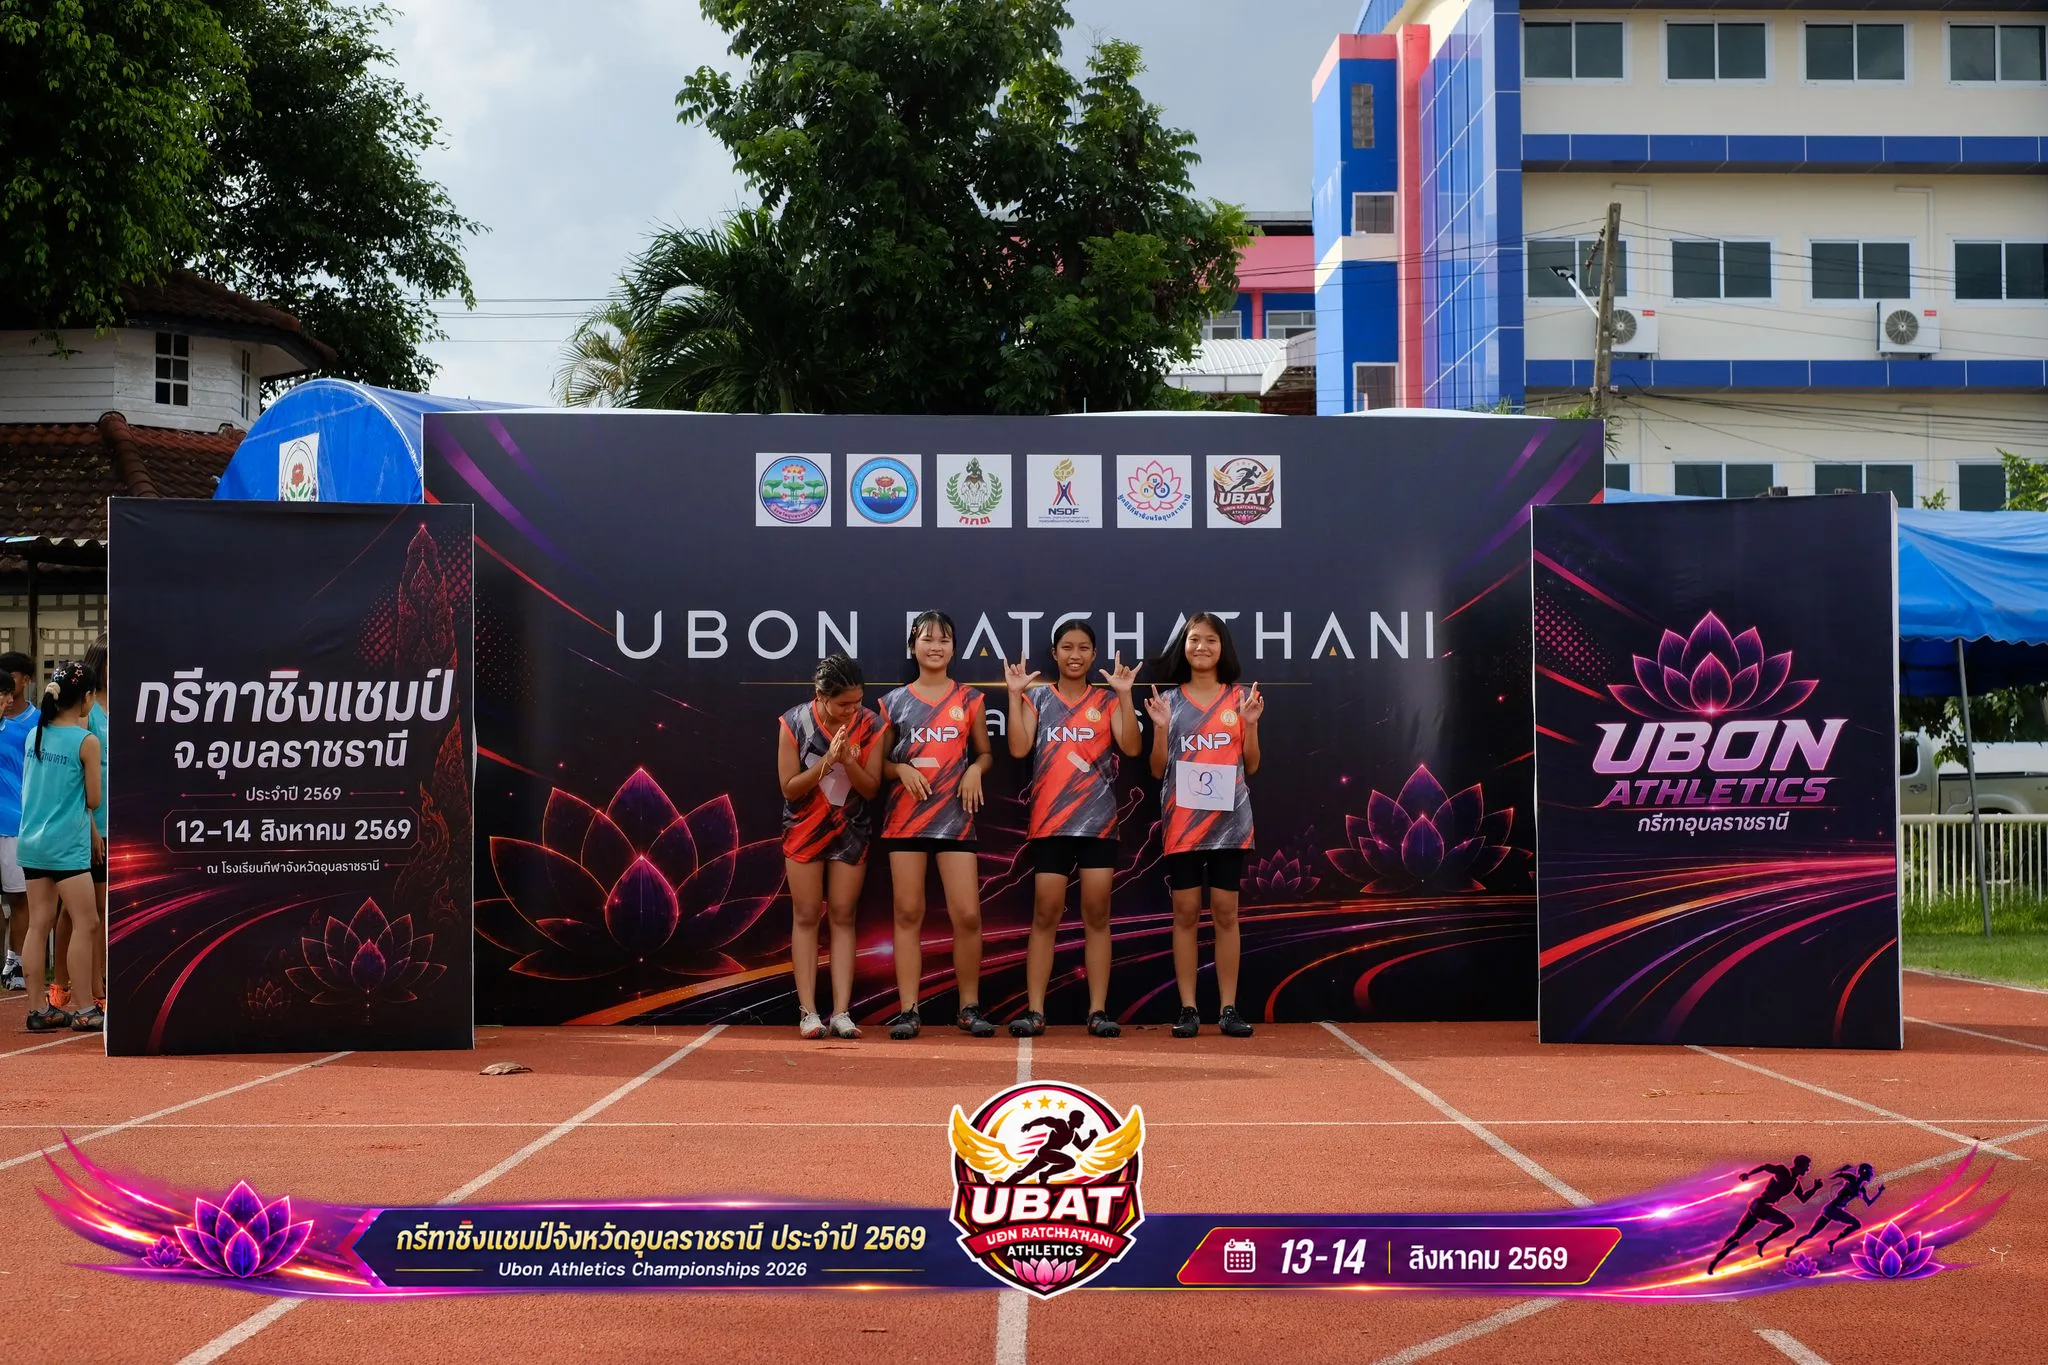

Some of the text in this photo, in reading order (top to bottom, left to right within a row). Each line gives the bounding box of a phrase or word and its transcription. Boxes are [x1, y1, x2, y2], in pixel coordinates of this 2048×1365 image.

[1218, 492, 1270, 505] UBAT
[958, 515, 991, 526] กกท
[1048, 507, 1080, 516] NSDF
[616, 609, 859, 660] UBON
[135, 667, 455, 723] กรีฑาชิงแชมป์
[910, 726, 960, 744] KNP
[1046, 726, 1096, 743] KNP
[1180, 732, 1232, 752] KNP
[173, 729, 409, 779] จ.อุบลราชธานี
[1592, 718, 1849, 774] UBON
[1195, 771, 1213, 796] 3
[1596, 777, 1836, 806] ATHLETICS
[245, 786, 342, 802] ประจำปี 2569
[260, 819, 347, 842] สิงหาคม
[354, 819, 412, 841] 2569
[206, 859, 380, 875] ณ โรงเรียนกีฬาจังหวัดอุบลราชธานี
